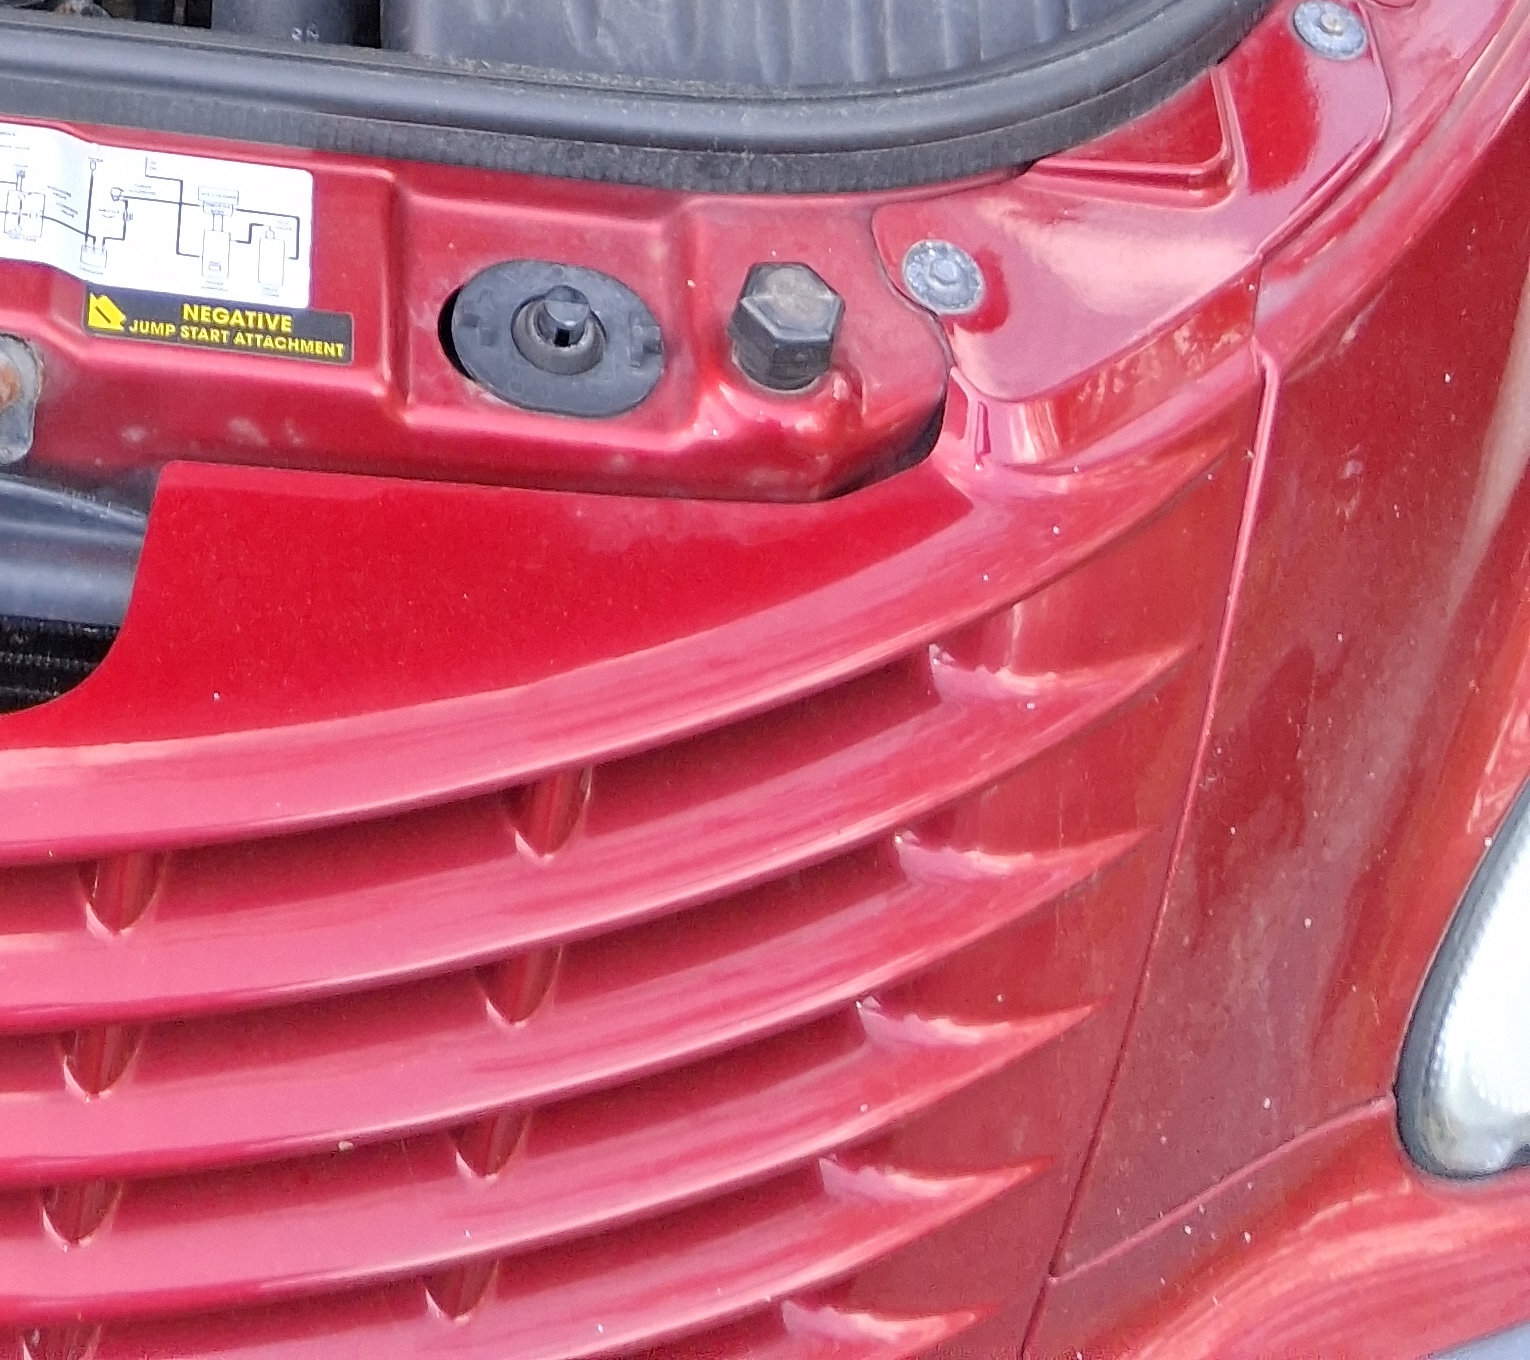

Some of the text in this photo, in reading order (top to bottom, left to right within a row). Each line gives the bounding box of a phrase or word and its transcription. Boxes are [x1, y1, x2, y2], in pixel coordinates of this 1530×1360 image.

[181, 303, 293, 334] NEGATIVE
[129, 319, 345, 358] JUMP START ATTACHMENT
